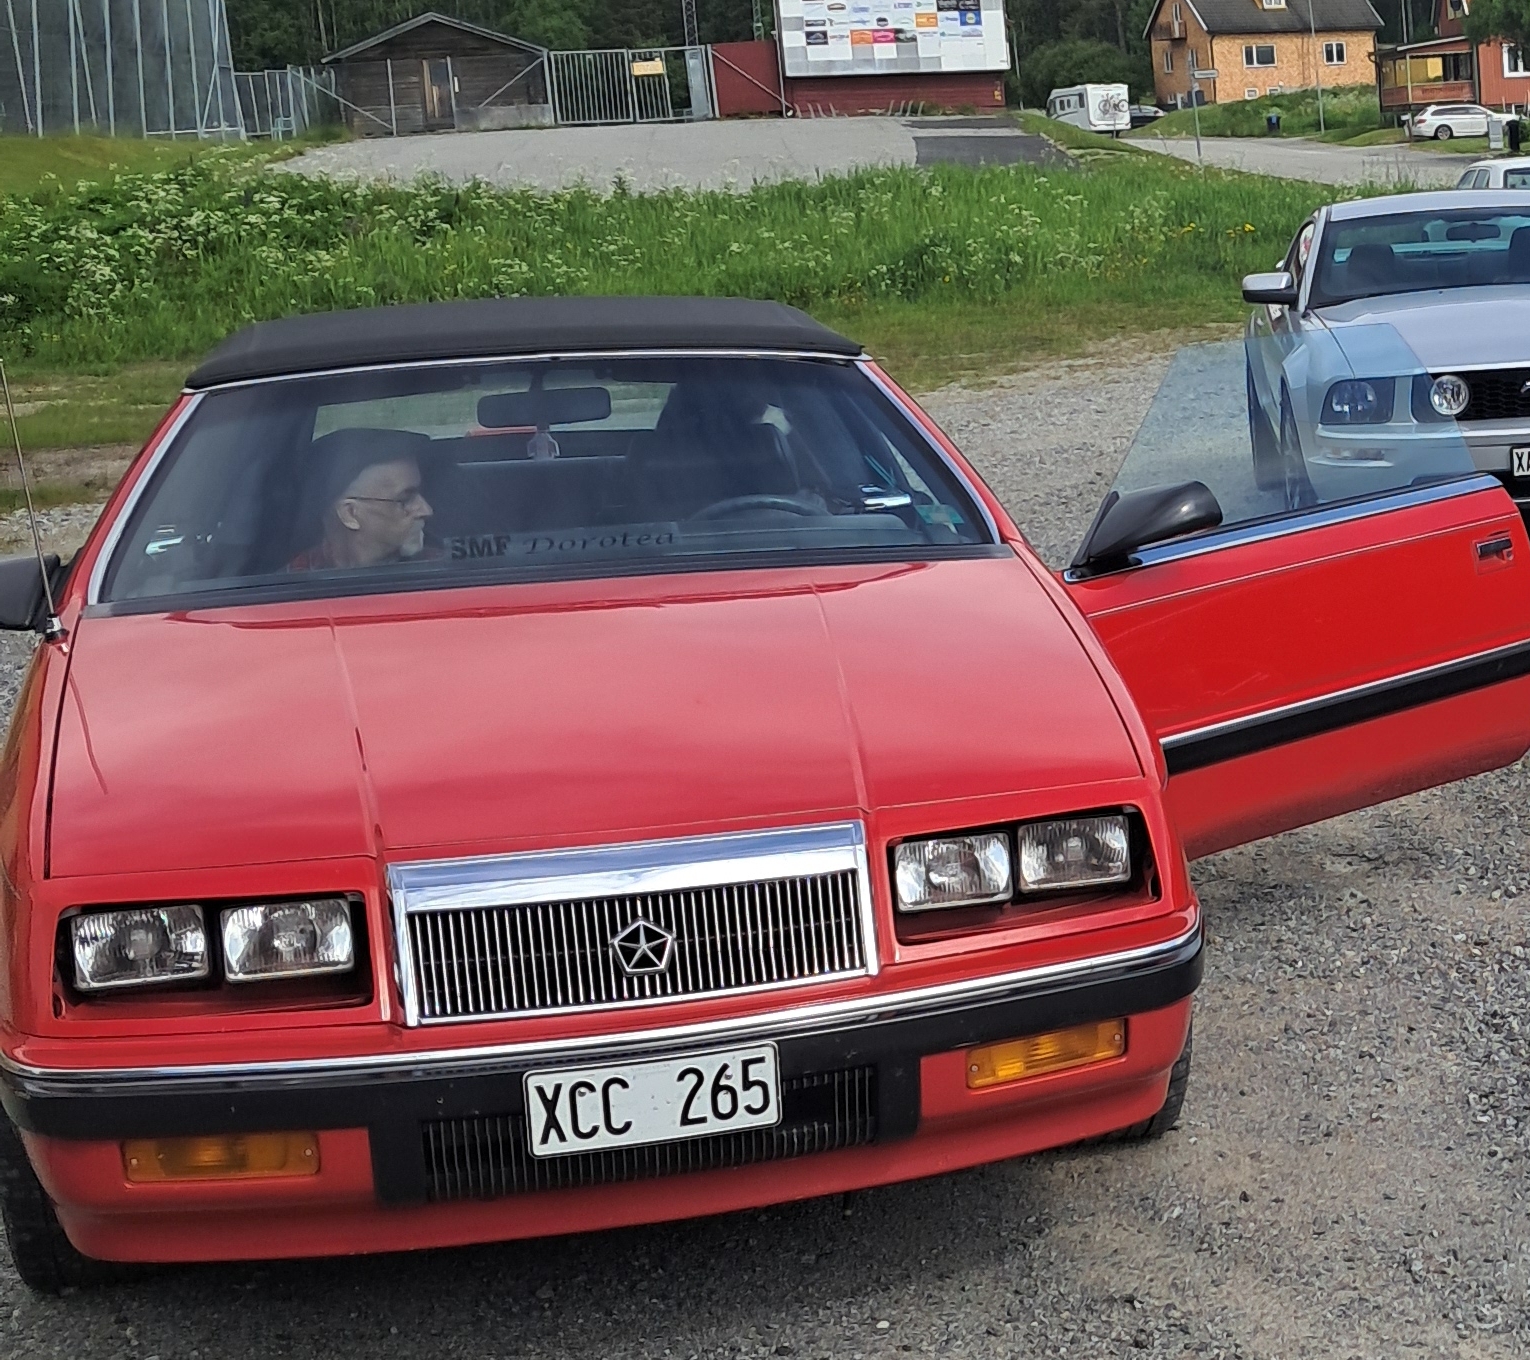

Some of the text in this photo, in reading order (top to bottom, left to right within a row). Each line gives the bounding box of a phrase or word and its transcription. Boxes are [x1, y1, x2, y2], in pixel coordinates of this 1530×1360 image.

[451, 531, 674, 560] SMF Dorotea
[534, 1055, 771, 1146] XCC 265
